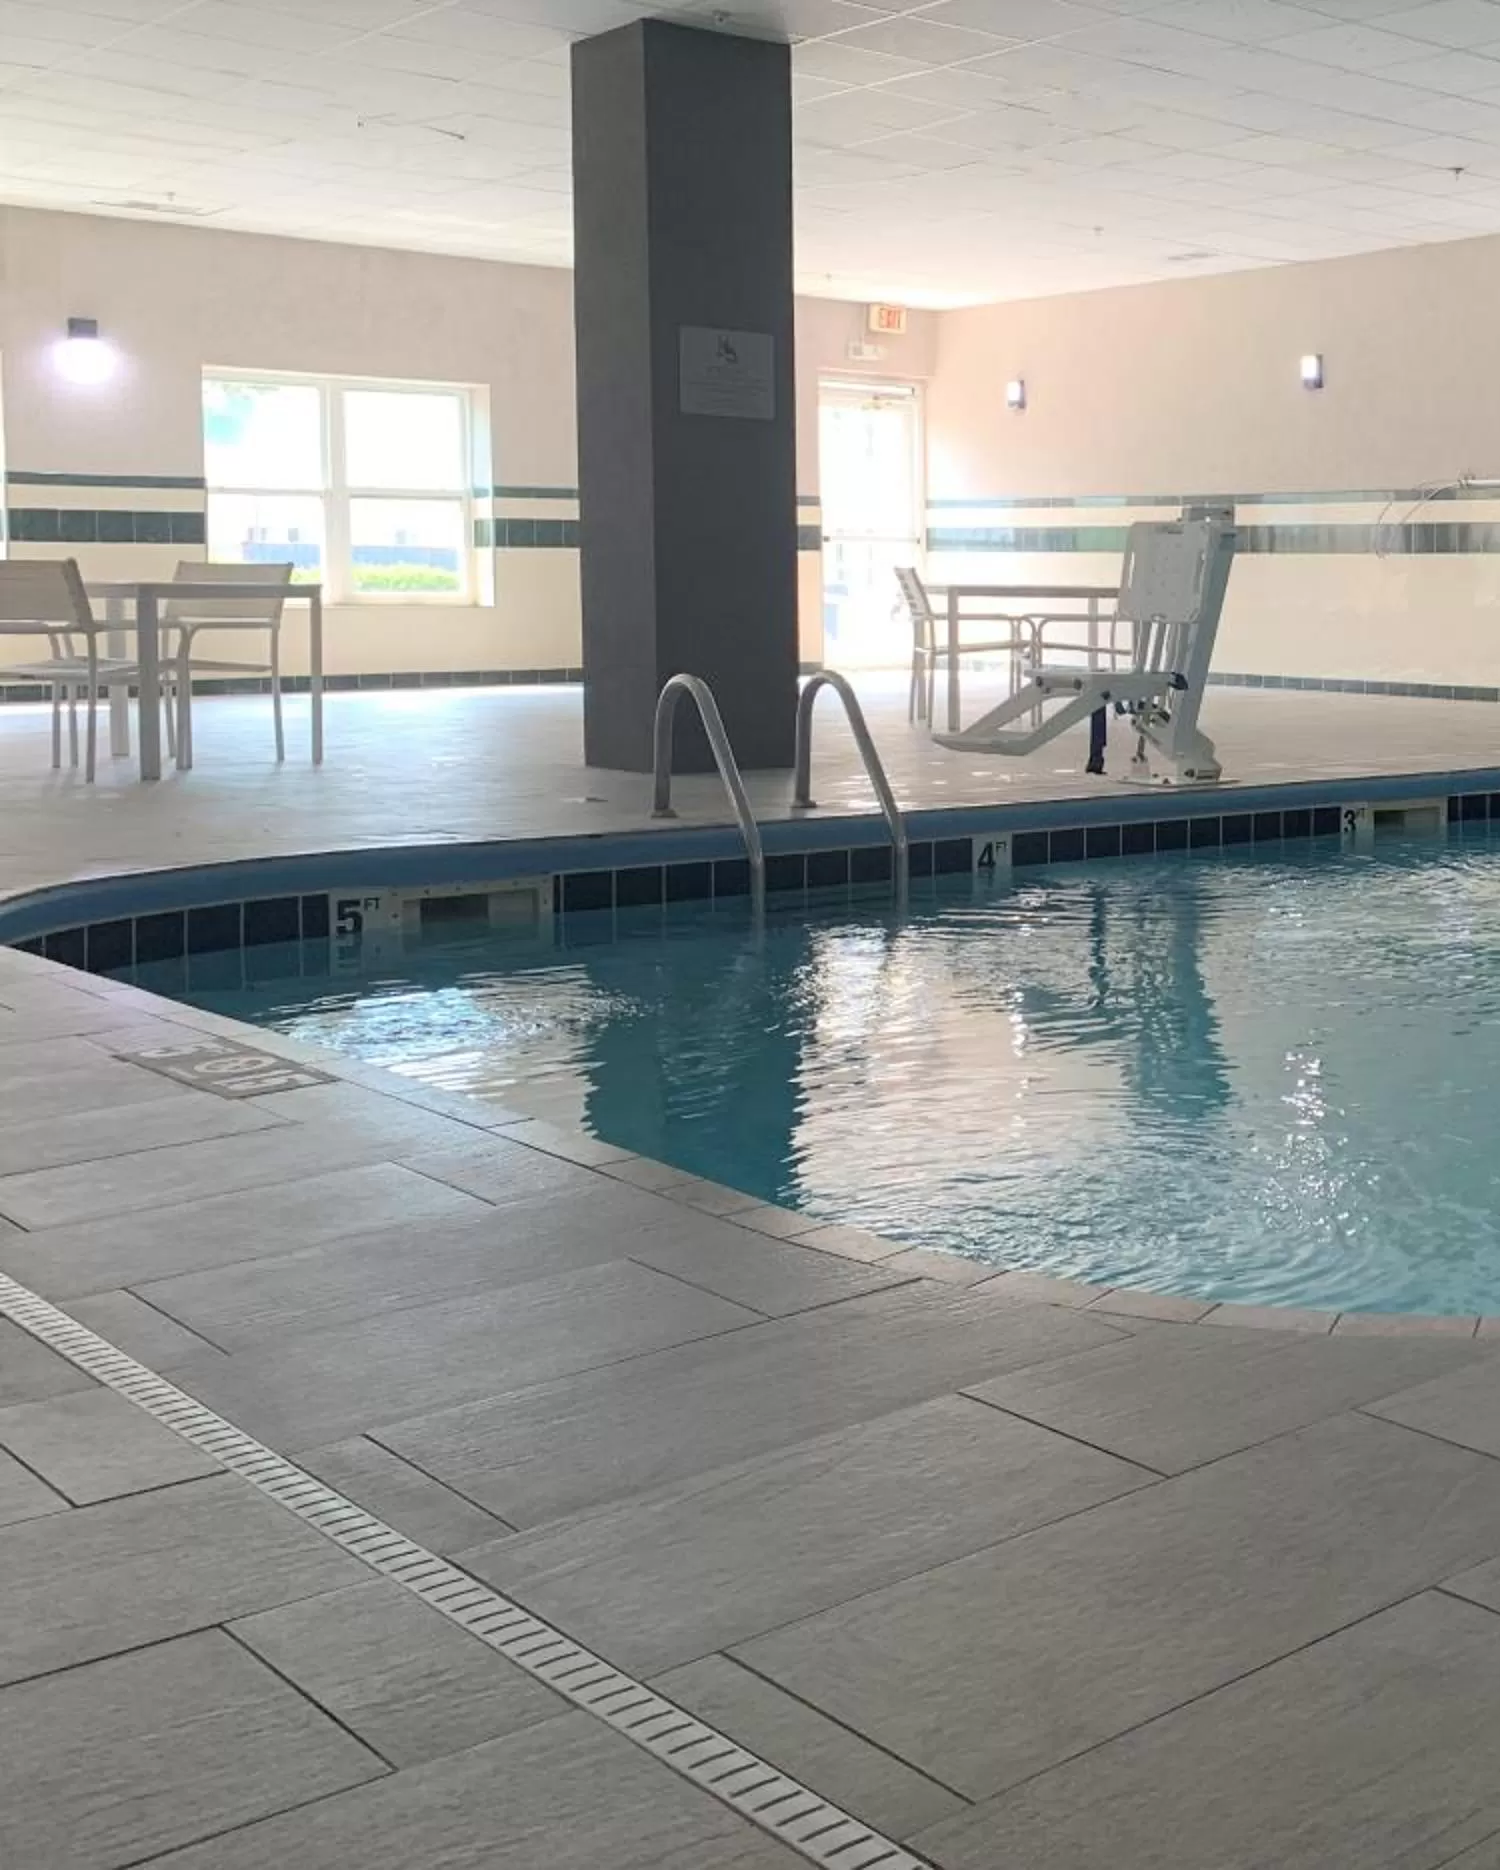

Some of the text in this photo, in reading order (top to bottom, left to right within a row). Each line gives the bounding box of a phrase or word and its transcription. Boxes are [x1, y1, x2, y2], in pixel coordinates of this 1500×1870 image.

[878, 307, 903, 329] EXIT
[1344, 809, 1356, 832] 3
[978, 841, 996, 868] 4
[336, 899, 363, 934] 5
